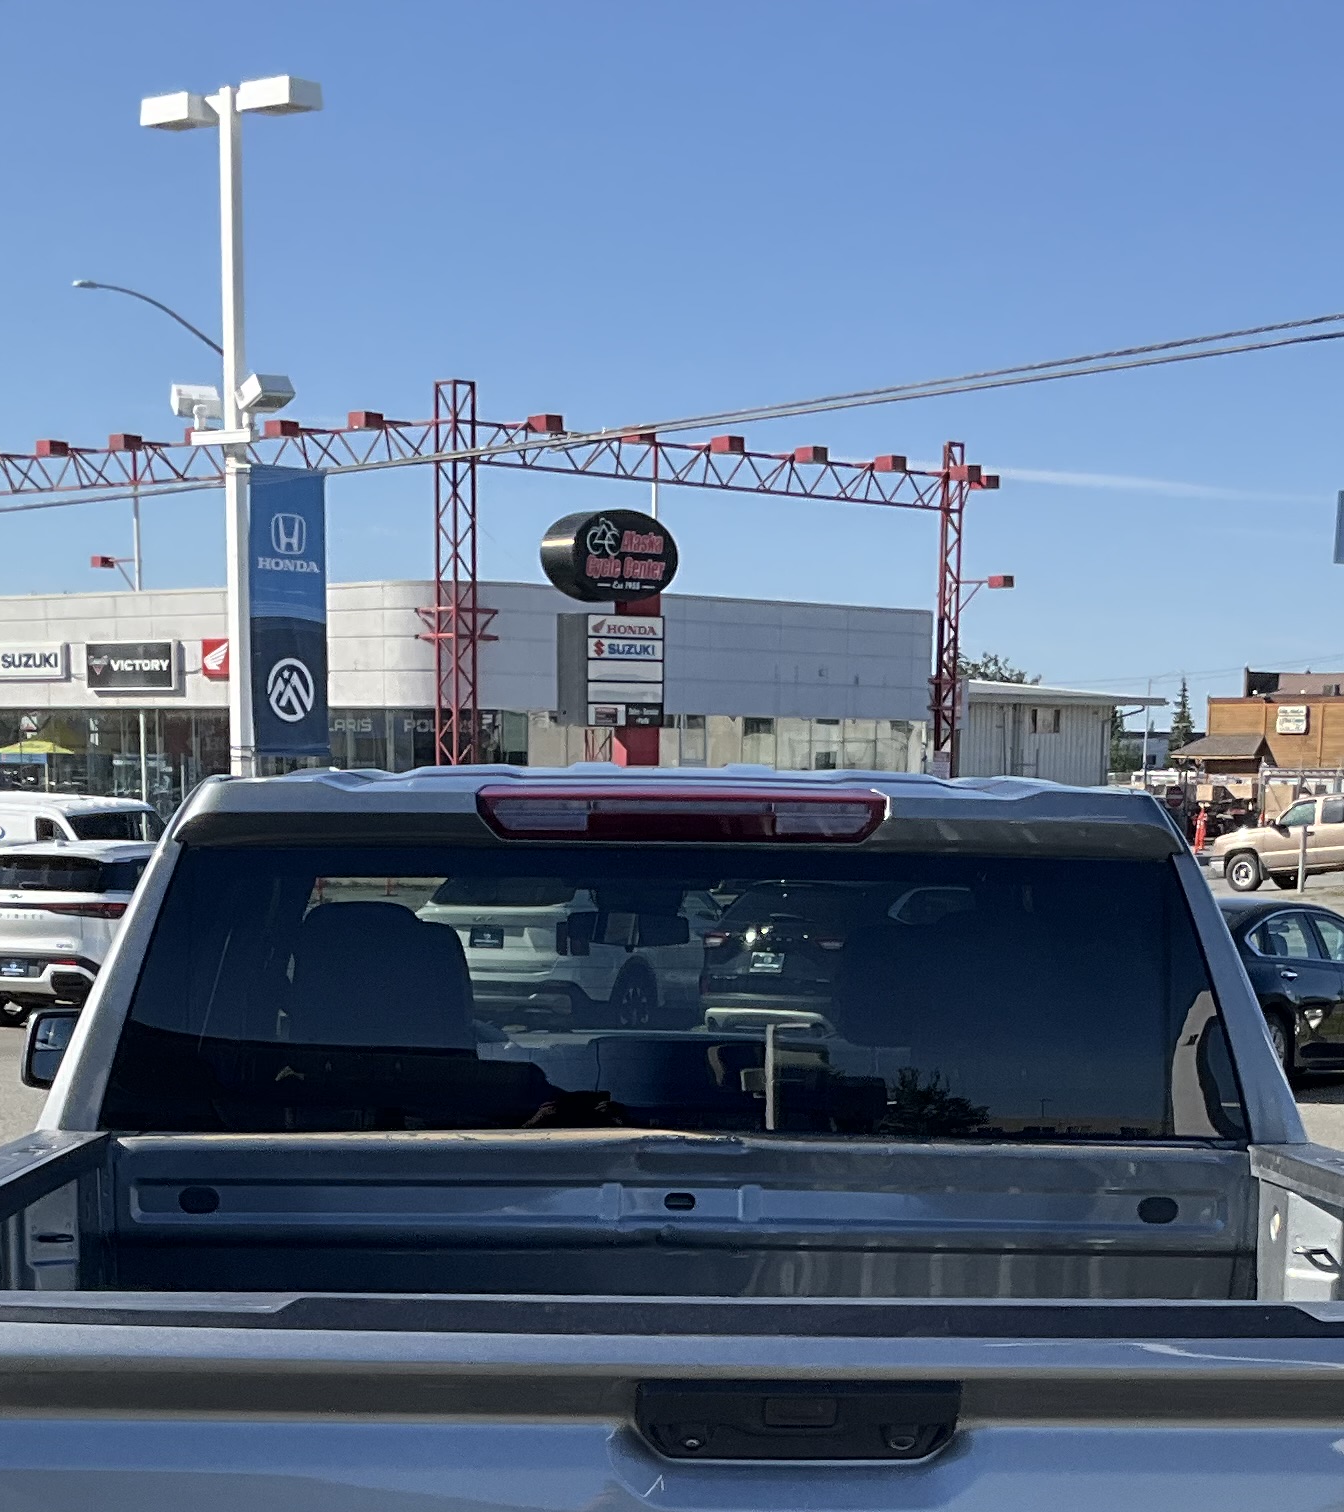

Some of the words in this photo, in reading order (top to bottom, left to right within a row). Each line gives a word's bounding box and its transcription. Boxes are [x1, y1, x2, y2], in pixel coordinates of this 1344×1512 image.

[620, 530, 664, 554] Alaska
[257, 556, 321, 574] HONDA
[586, 553, 622, 579] Cycle
[623, 556, 666, 580] Center
[606, 624, 657, 636] HONDA
[607, 643, 656, 656] SUZUKI
[1, 651, 59, 669] SUZUKI
[110, 659, 170, 672] VICTORY
